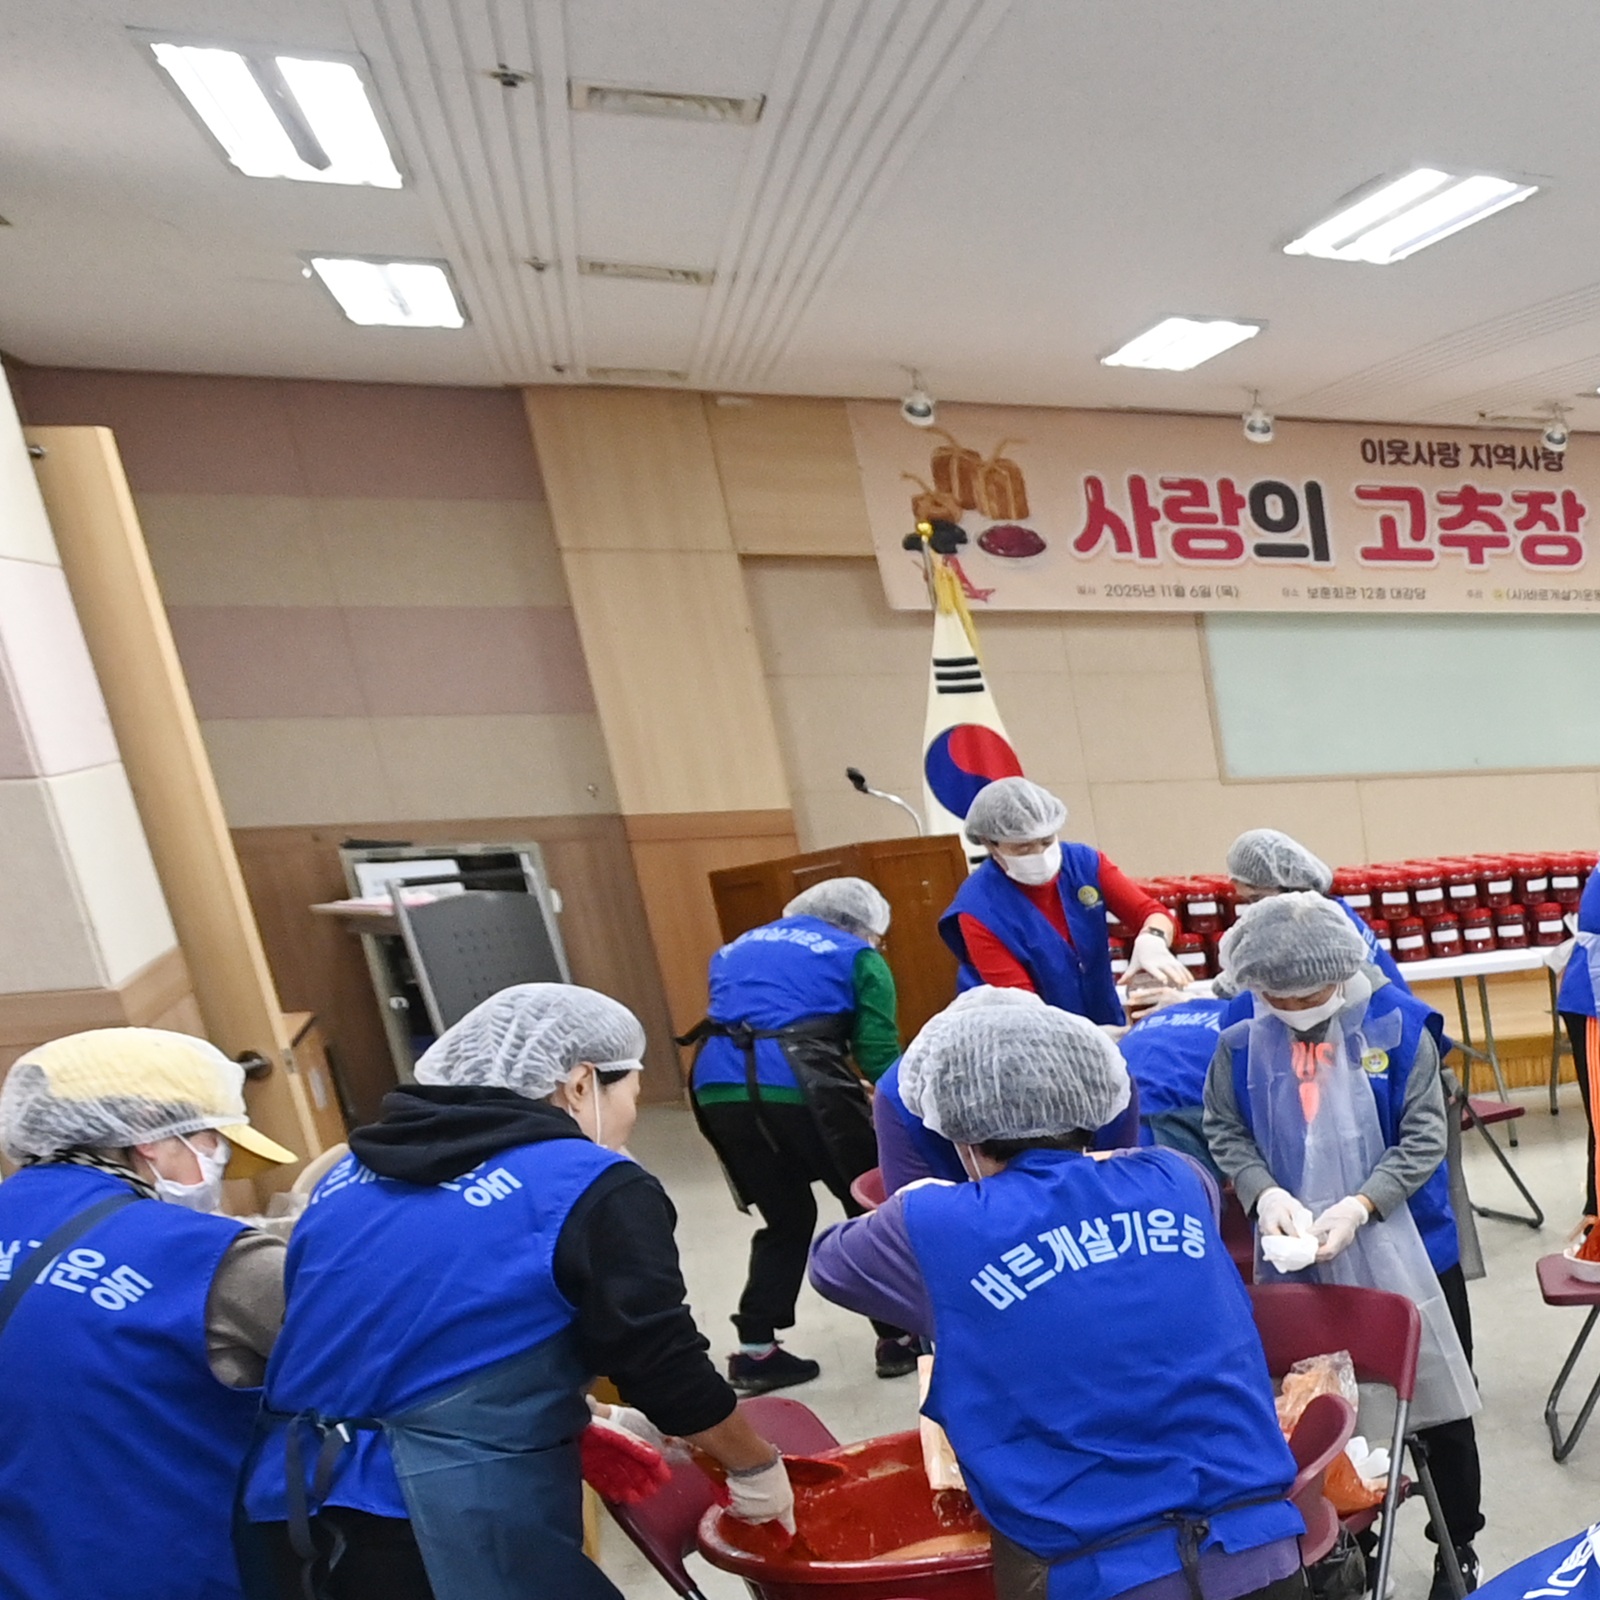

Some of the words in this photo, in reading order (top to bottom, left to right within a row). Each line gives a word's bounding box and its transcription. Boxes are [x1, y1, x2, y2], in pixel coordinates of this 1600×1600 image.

[1360, 438, 1460, 469] 이웃사랑
[1469, 442, 1565, 473] 지역사랑
[1073, 474, 1331, 562] 사랑의
[1354, 483, 1586, 566] 고추장
[1104, 584, 1155, 598] 2025년
[1161, 585, 1185, 598] 11월
[1189, 585, 1211, 598] 6일
[1215, 585, 1239, 599] (목)
[1390, 588, 1426, 600] 대강당
[970, 1207, 1206, 1311] 바르게살기운동
